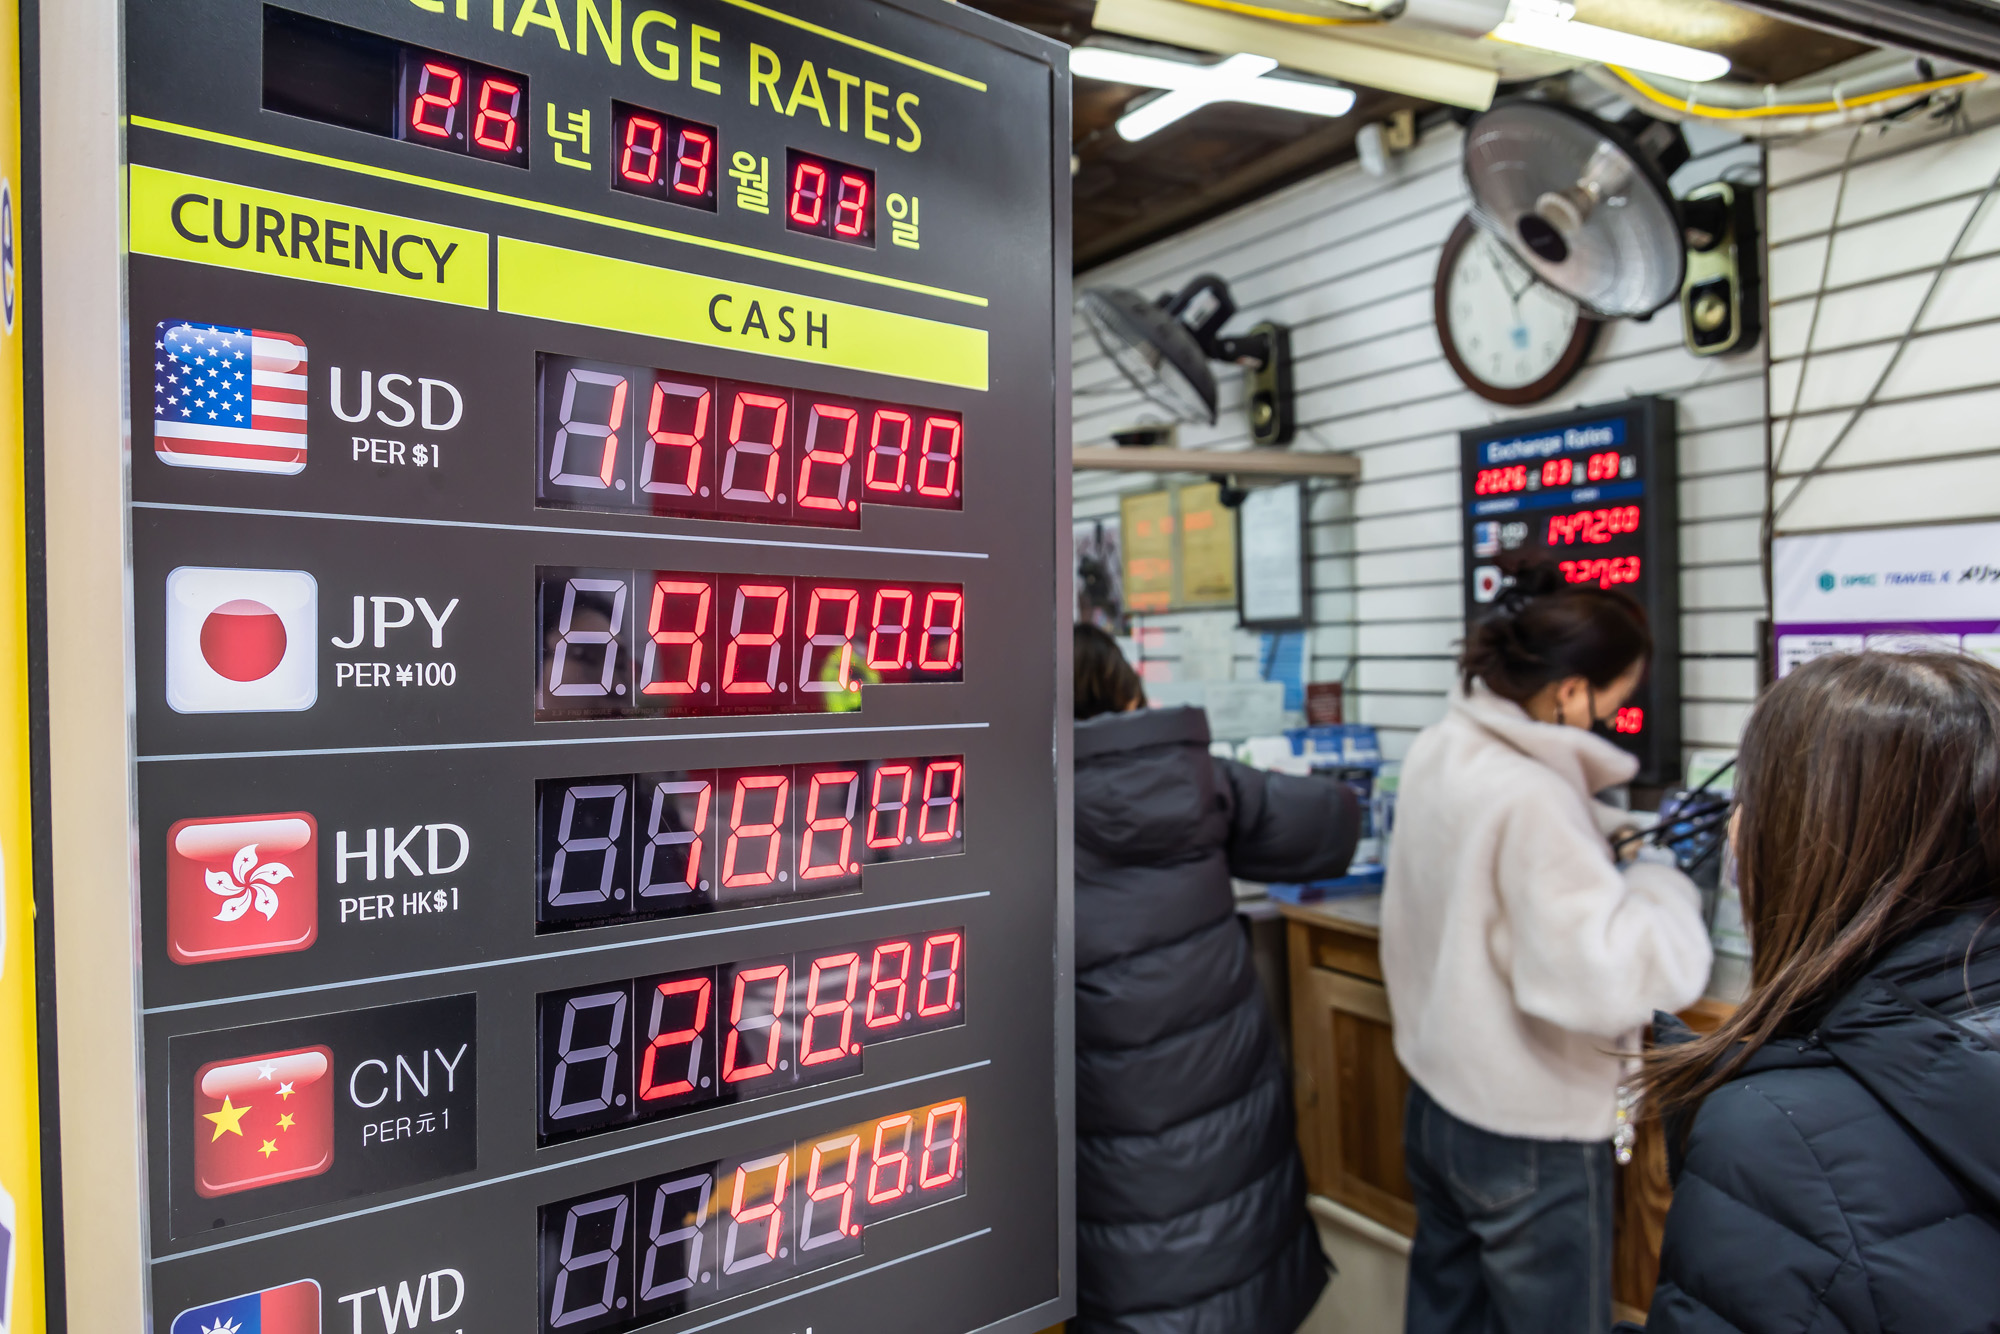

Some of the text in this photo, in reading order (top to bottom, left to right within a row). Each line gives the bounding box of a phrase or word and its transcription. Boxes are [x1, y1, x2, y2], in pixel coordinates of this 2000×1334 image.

[748, 42, 923, 153] RATES
[411, 63, 920, 250] 26 년 03 월 03 일
[170, 193, 459, 284] CURRENCY
[708, 294, 829, 349] CASH
[330, 366, 464, 431] USD
[351, 436, 440, 469] PER $1
[1475, 465, 1526, 495] 2026
[330, 595, 460, 649] JPY
[335, 662, 457, 688] PER ¥100
[336, 823, 470, 884] HKD
[339, 887, 459, 924] PER HK$1
[349, 1043, 468, 1108] CNY
[363, 1117, 412, 1147] PER
[337, 1268, 465, 1334] TWD
